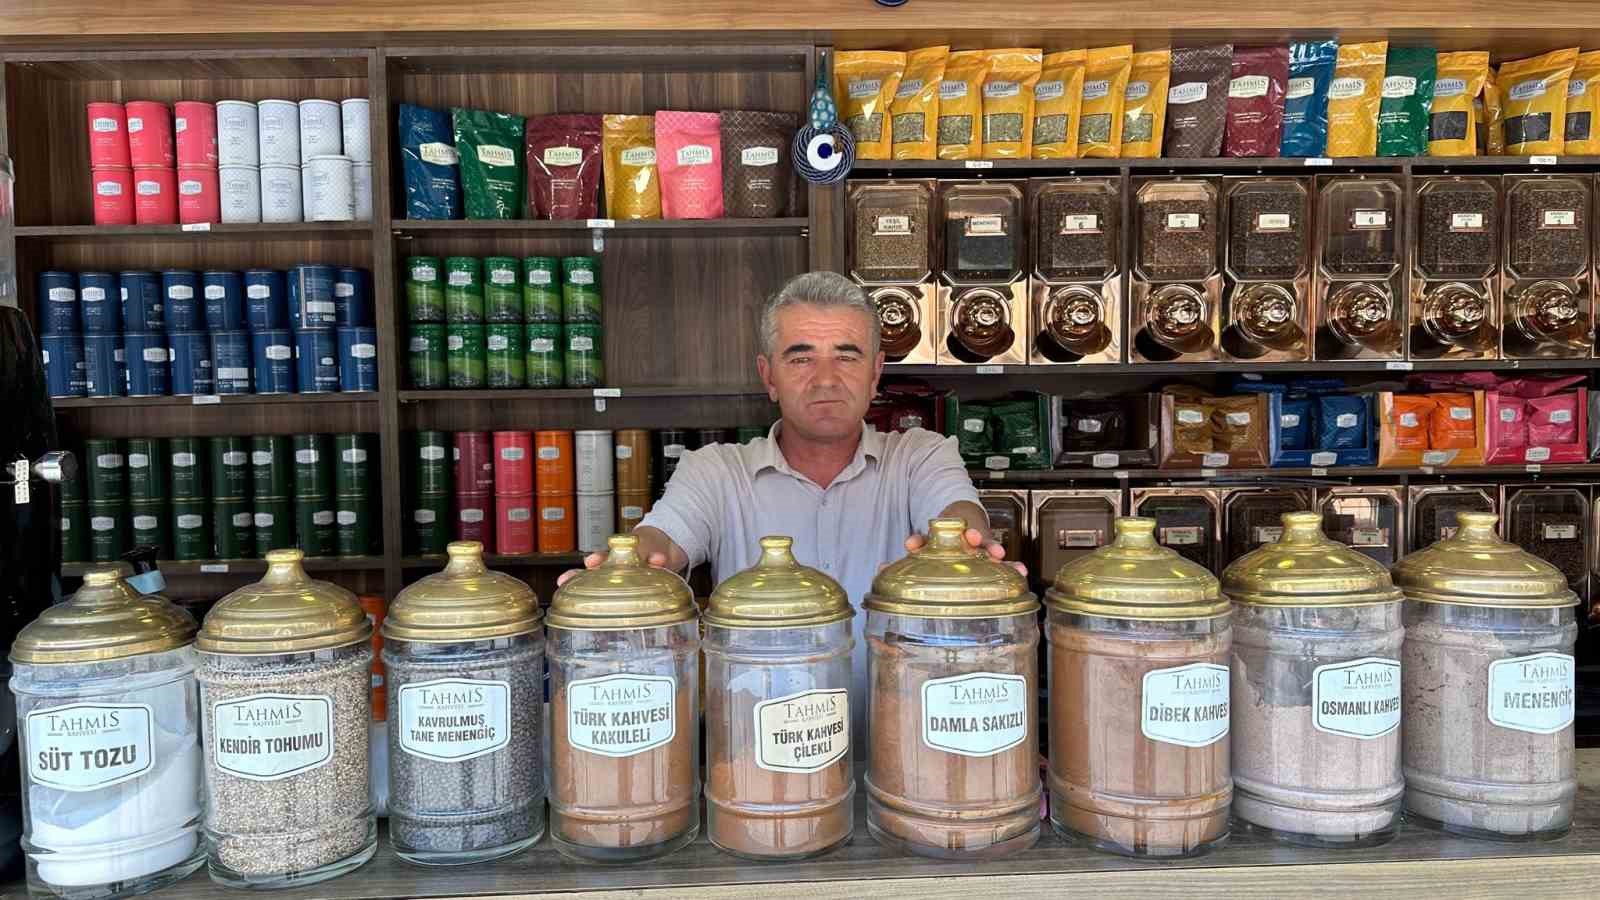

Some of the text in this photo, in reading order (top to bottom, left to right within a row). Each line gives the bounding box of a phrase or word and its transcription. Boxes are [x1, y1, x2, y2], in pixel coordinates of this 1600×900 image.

[573, 702, 670, 727] TÜRK KAHVESİ
[1149, 702, 1190, 722] DİBEK
[1321, 700, 1372, 716] OSMANLI
[418, 713, 486, 729] KAVRULMUŞ
[772, 716, 844, 745] TÜRK KAHVESİ
[929, 711, 1024, 733] DAMLA SAKIZLI
[219, 731, 324, 755] KENDİR TOHUMU
[410, 725, 496, 743] TANE MENENGİÇ
[591, 727, 651, 745] KAKULELİ
[39, 743, 137, 771] SÜT TOZU
[793, 736, 832, 762] ÇİLEKLİ
